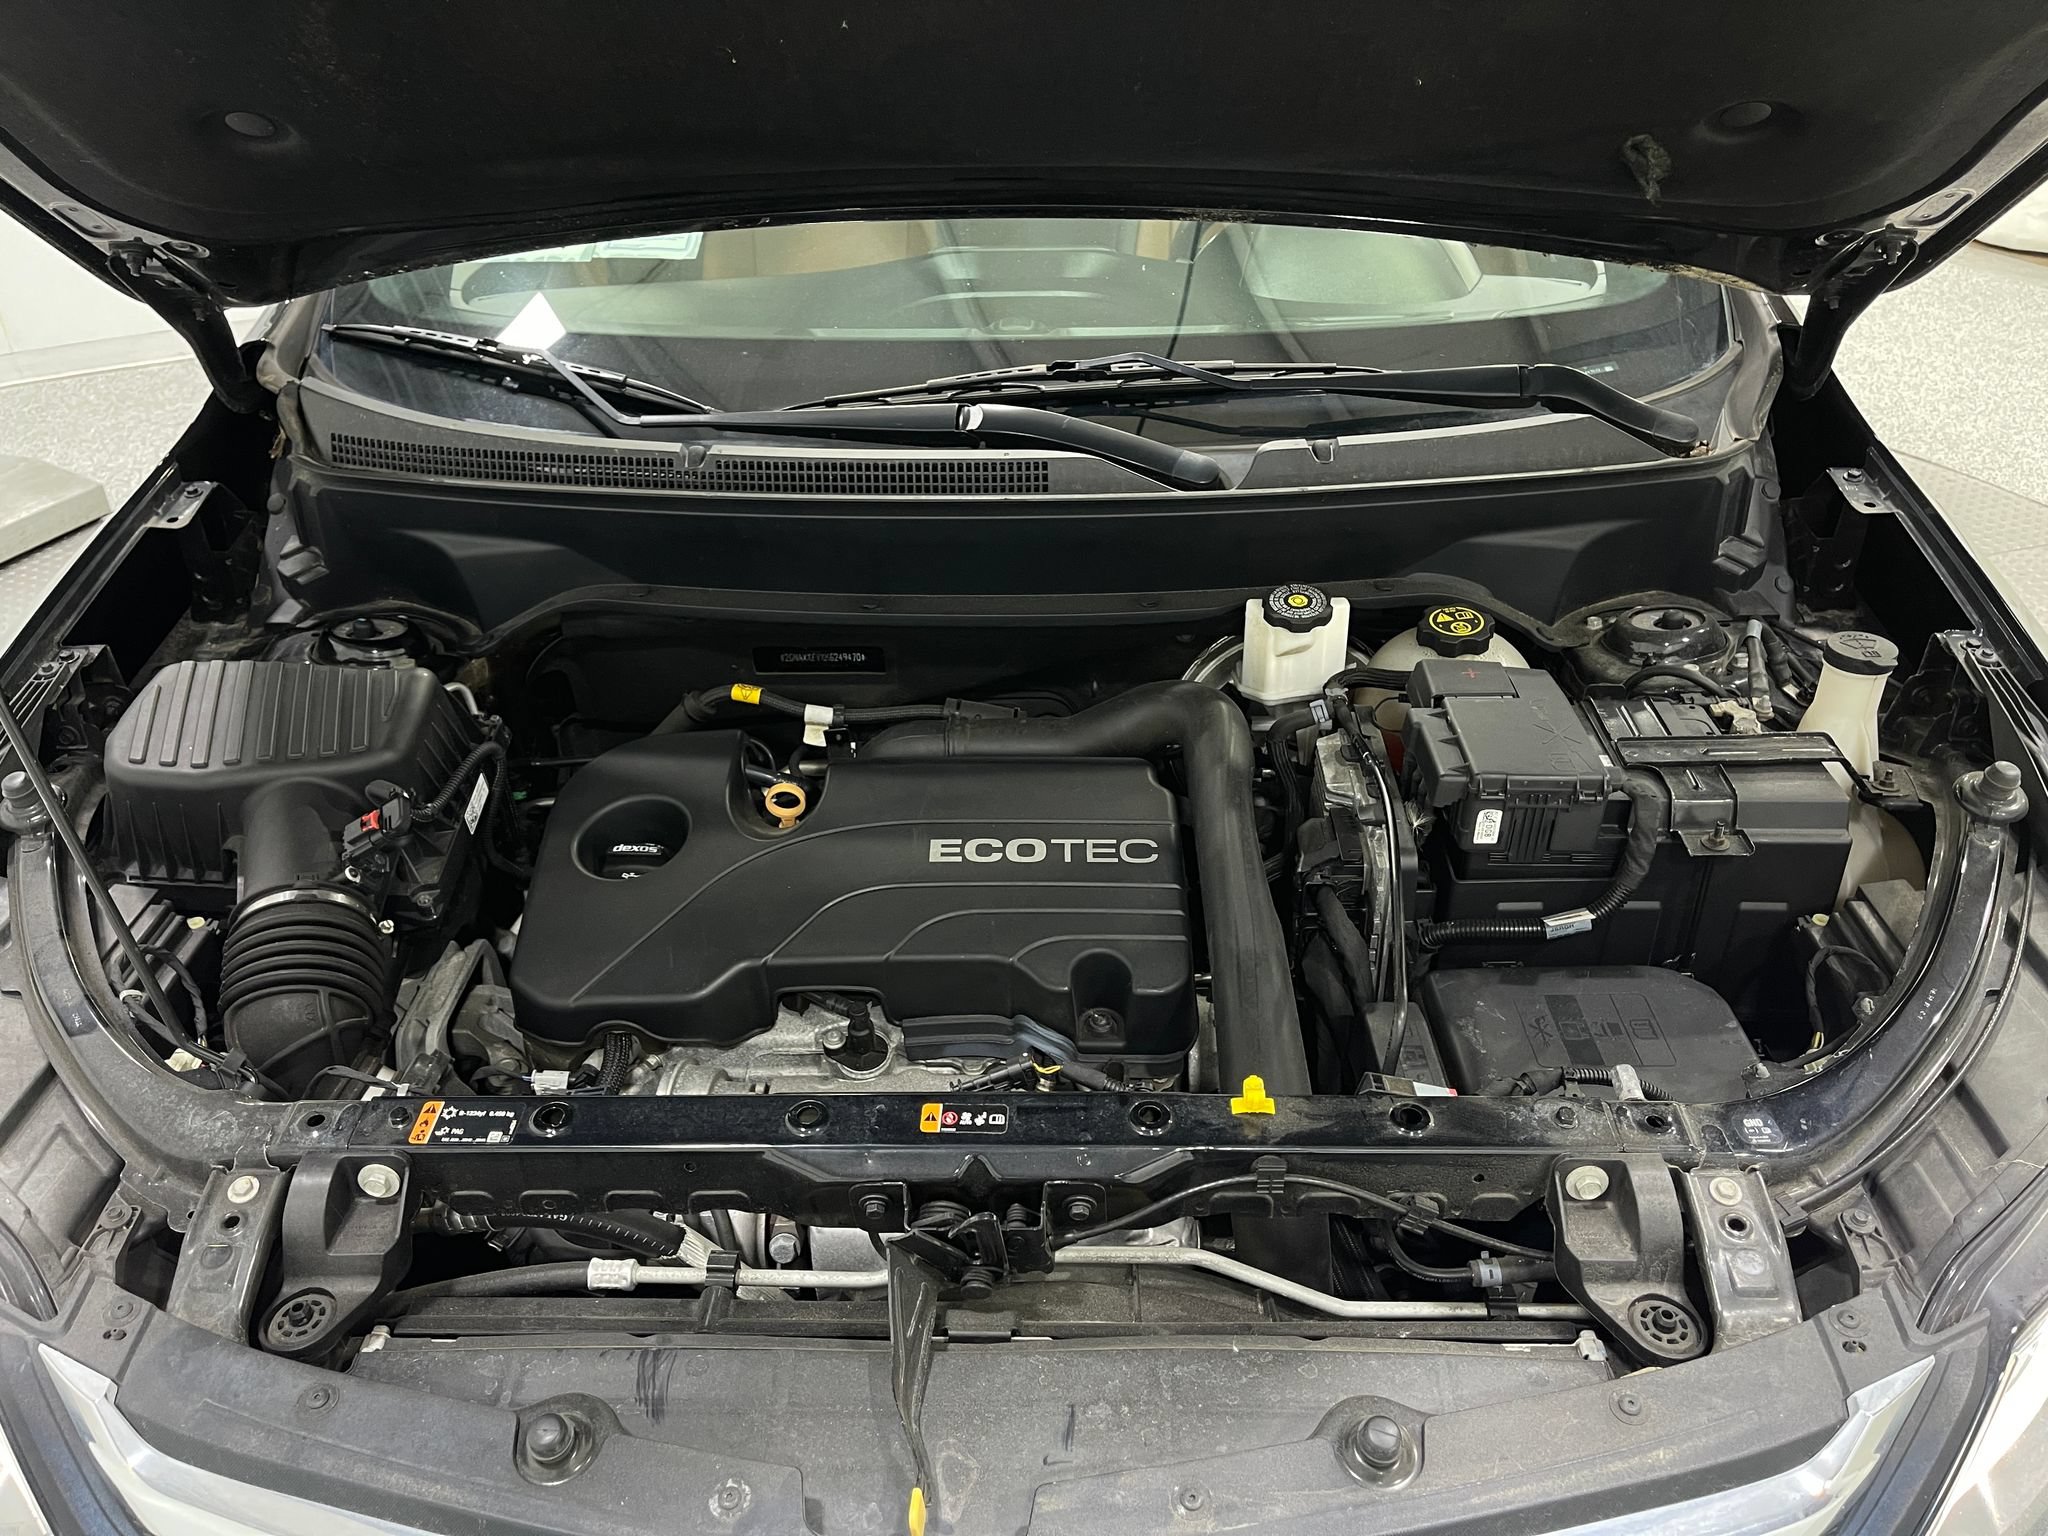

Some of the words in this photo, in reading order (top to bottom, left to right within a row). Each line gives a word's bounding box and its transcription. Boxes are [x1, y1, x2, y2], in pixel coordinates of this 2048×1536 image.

[612, 843, 658, 853] dexos
[928, 838, 1159, 864] ECOTEC
[1742, 1118, 1764, 1127] GND
[450, 1127, 465, 1135] PAG
